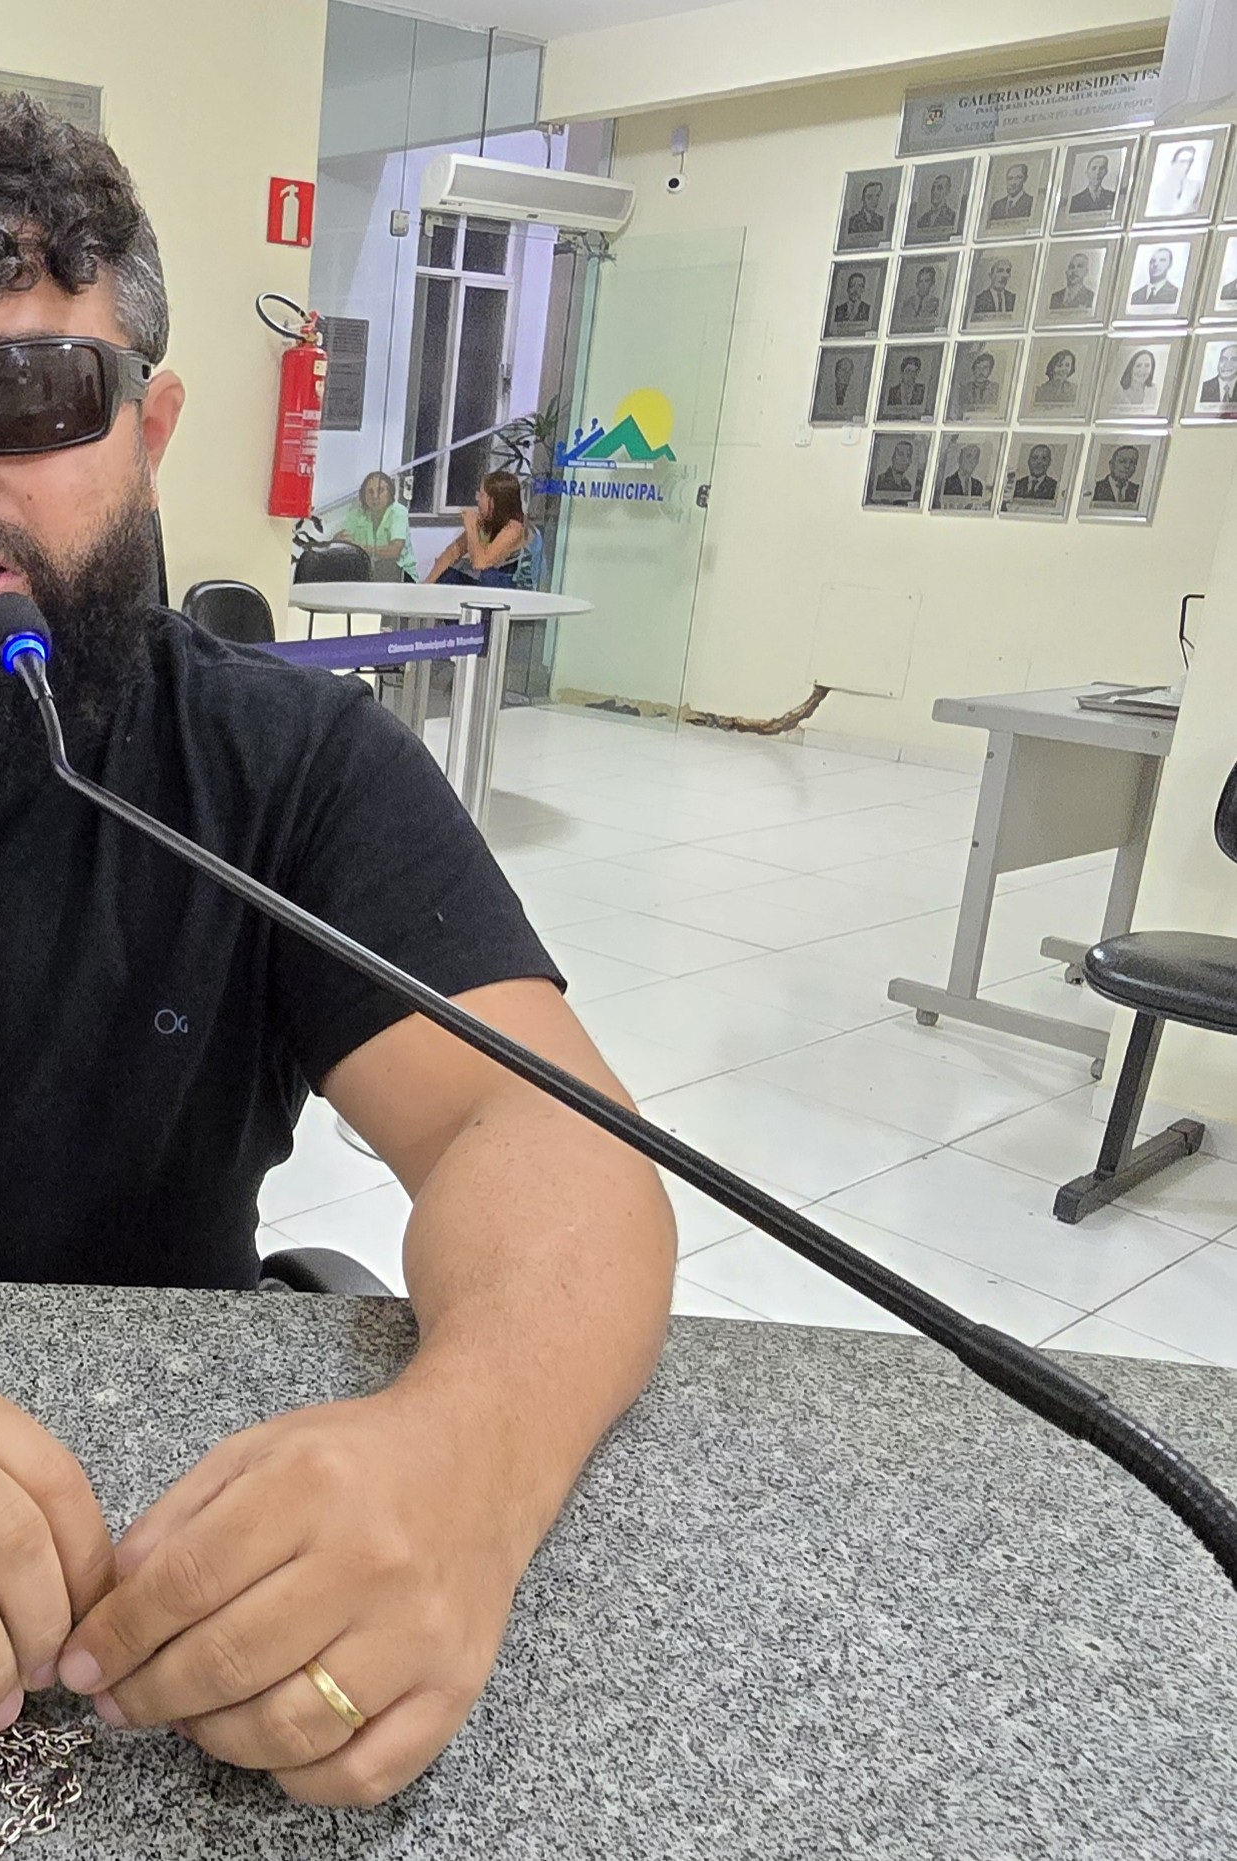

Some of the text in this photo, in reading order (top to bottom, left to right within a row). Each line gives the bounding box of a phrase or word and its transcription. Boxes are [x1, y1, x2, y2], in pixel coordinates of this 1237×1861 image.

[958, 67, 1161, 109] GALERIA DOS PRESIDENTES
[590, 479, 664, 502] MUNICIPAL
